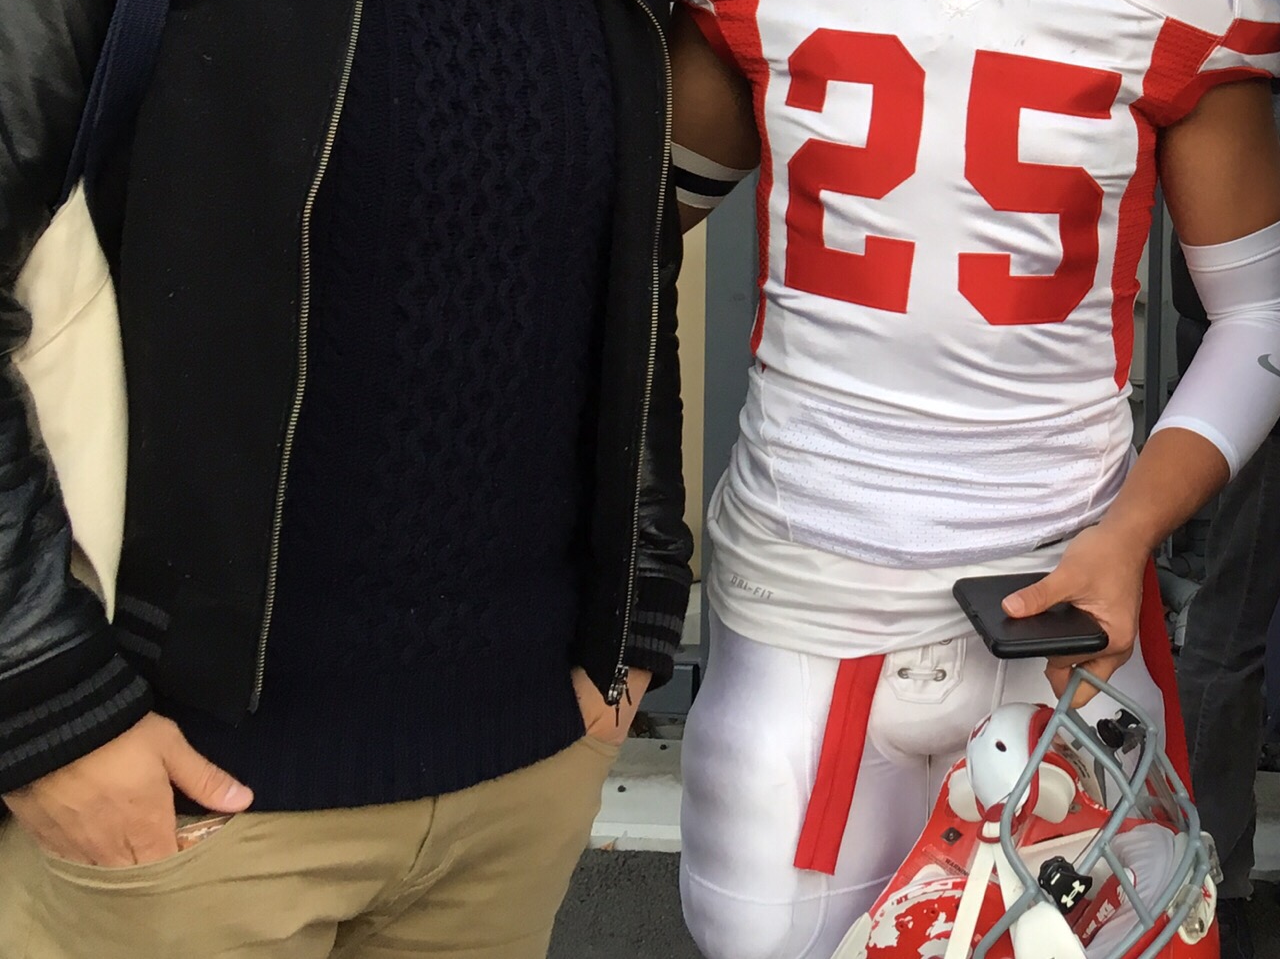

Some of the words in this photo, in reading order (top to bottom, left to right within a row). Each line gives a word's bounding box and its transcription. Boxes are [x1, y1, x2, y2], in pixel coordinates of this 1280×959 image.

[784, 27, 1123, 326] 25
[731, 574, 774, 600] DRI-FIT
[945, 857, 970, 877] WARNIN
